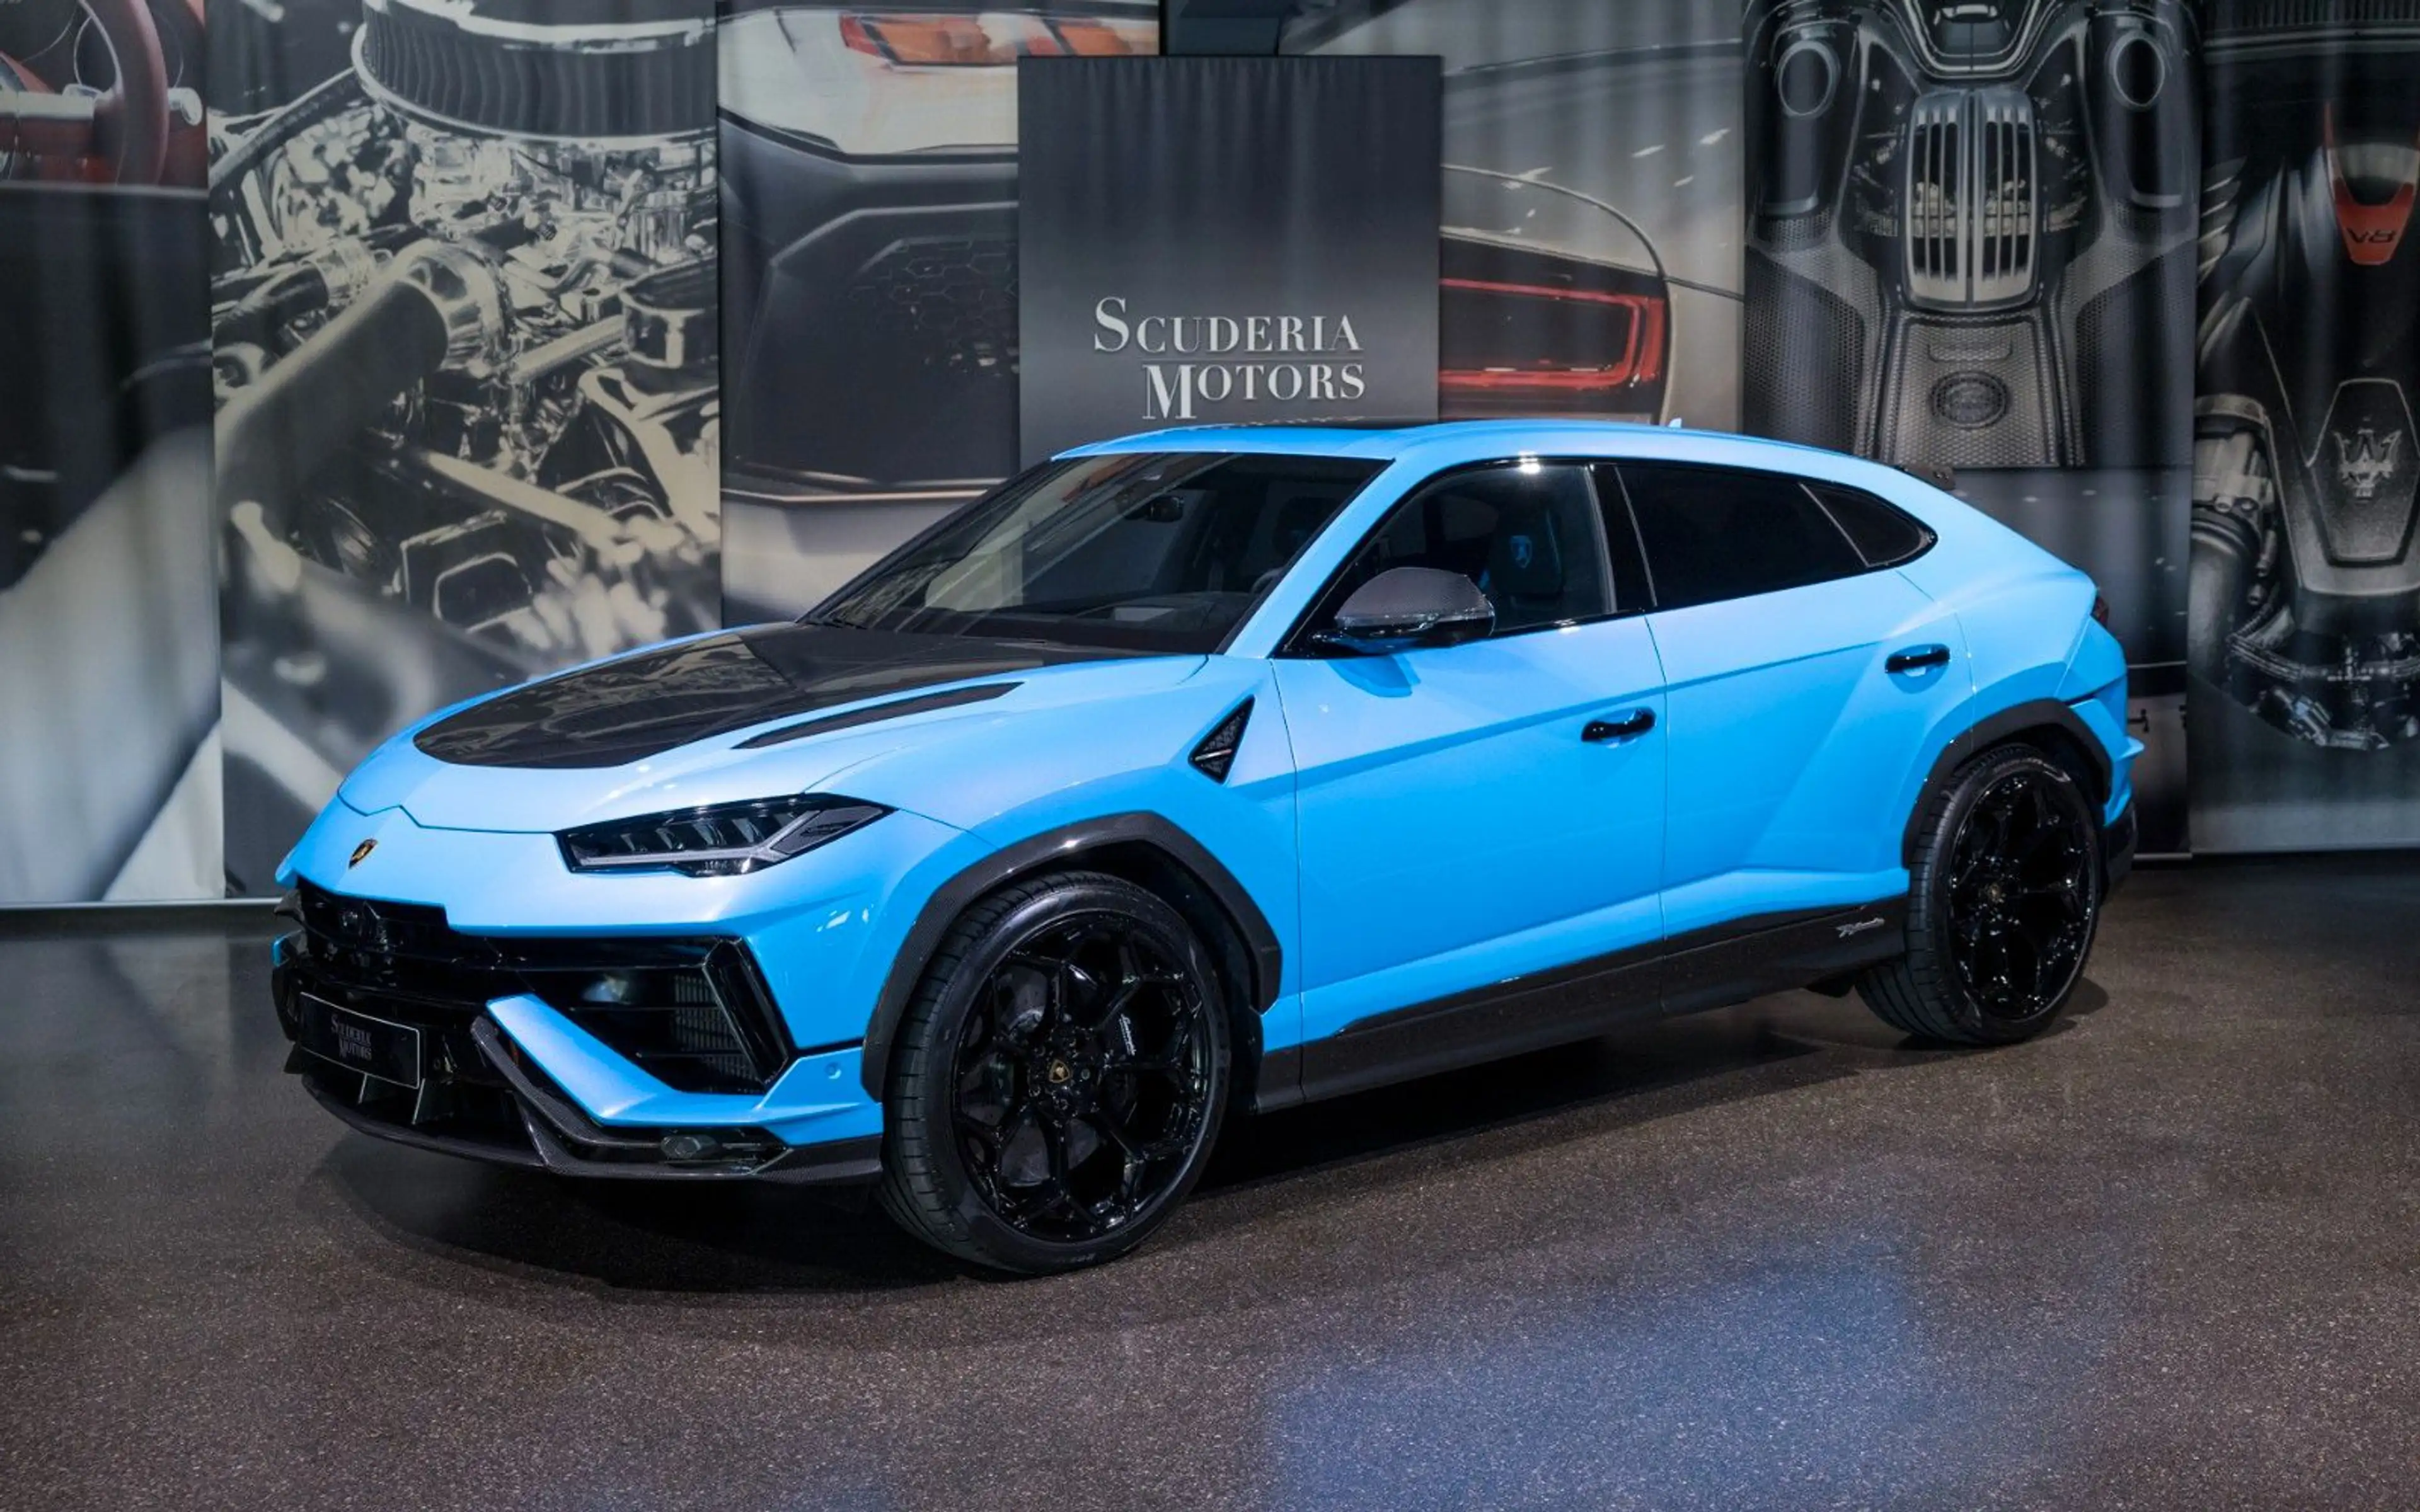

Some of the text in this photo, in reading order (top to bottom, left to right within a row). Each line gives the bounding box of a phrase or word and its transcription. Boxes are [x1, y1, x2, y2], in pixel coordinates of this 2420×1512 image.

[2347, 228, 2395, 243] V8
[1093, 296, 1364, 352] SCUDERIA
[1142, 363, 1366, 420] MOTORS
